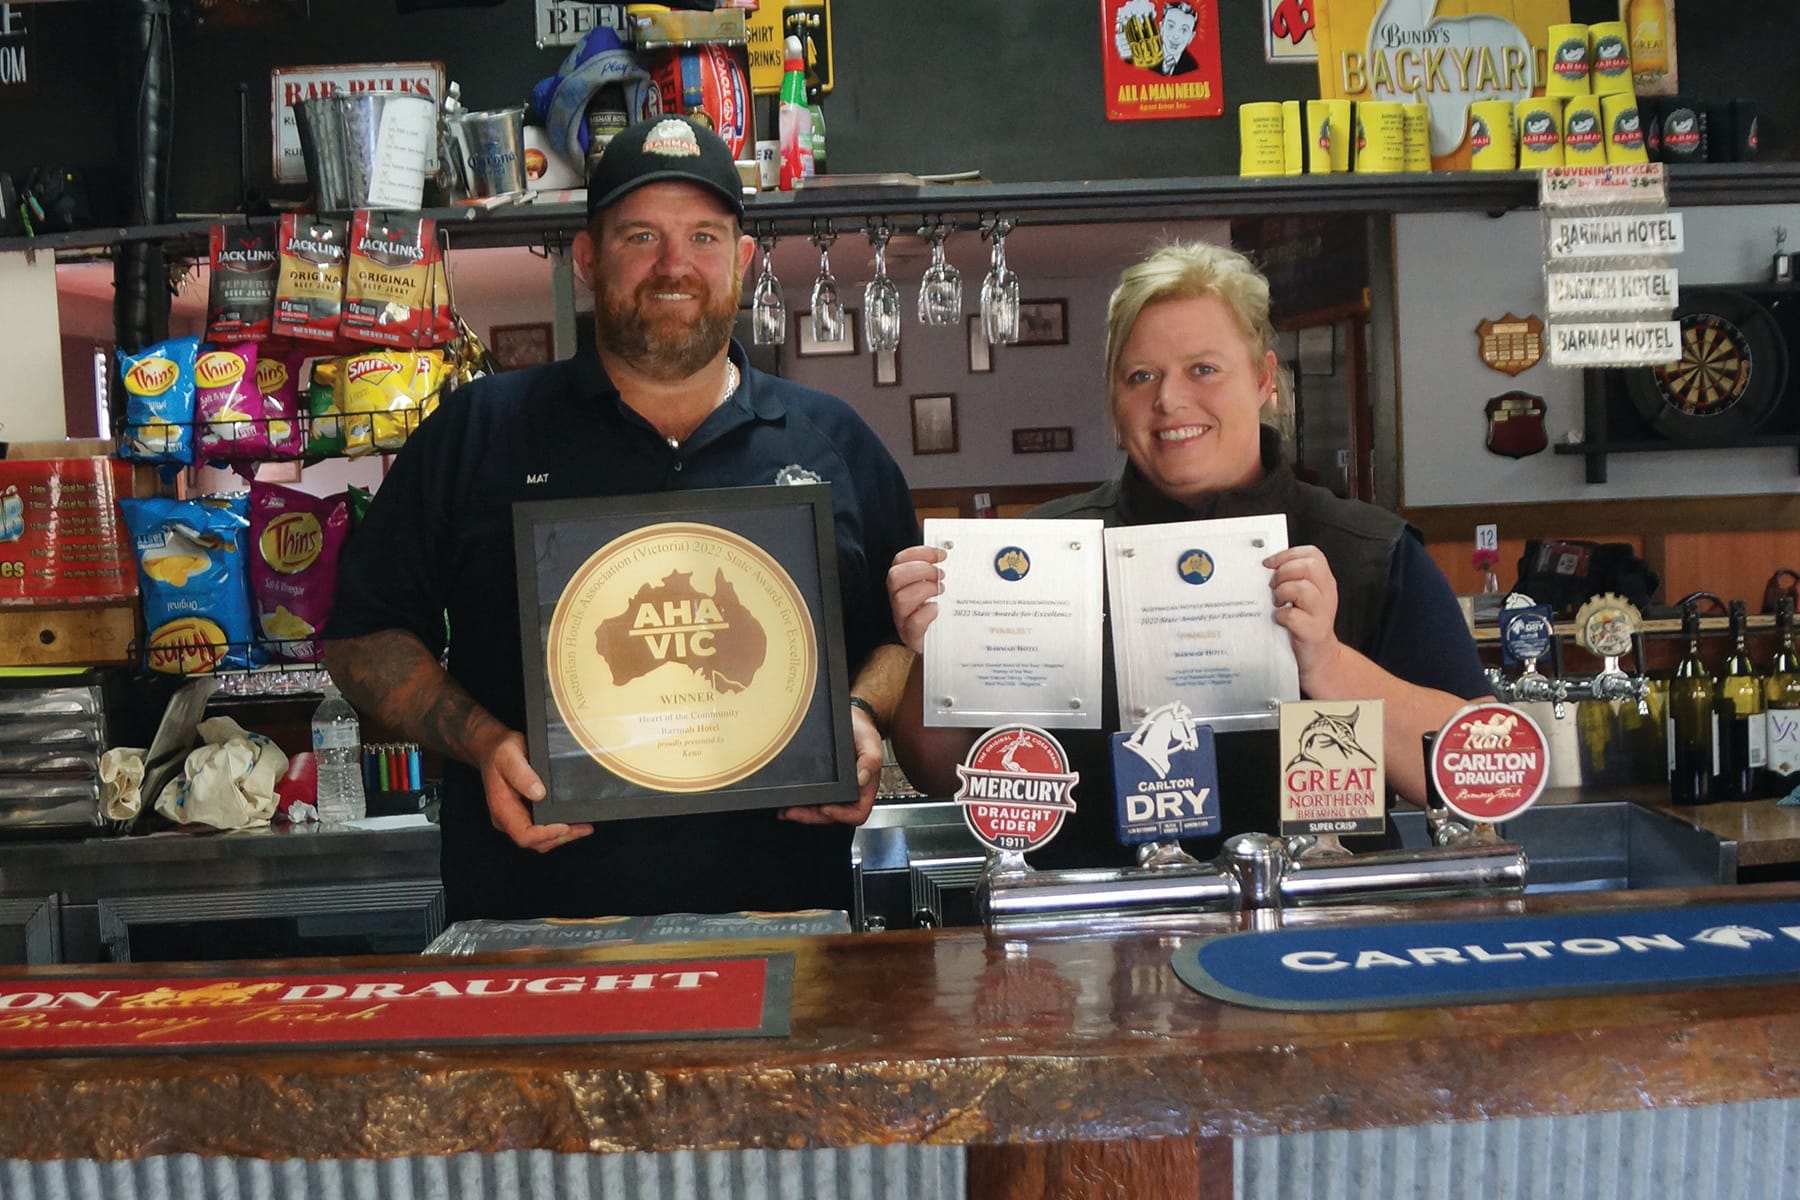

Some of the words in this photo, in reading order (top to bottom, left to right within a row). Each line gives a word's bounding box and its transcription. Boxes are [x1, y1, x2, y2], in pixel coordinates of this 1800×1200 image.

[546, 5, 627, 34] BEE
[1381, 22, 1450, 49] BUNDY'S
[1341, 45, 1547, 95] BACKYARD
[1554, 61, 1589, 74] BARMA
[1595, 57, 1631, 72] BARMA
[1118, 84, 1139, 102] ALL
[1140, 84, 1150, 102] A
[1149, 83, 1175, 101] MAN
[1175, 81, 1211, 100] NEEDS
[1546, 166, 1607, 178] SUVENIR
[1609, 163, 1659, 176] STICKES
[1560, 221, 1622, 247] BARMAH
[1627, 219, 1677, 243] HOTEL
[286, 238, 317, 253] JACK
[356, 237, 388, 254] JACK
[217, 250, 246, 263] JACK
[359, 271, 416, 288] ORIGINAL
[1558, 326, 1620, 351] BARMAH
[1624, 326, 1673, 350] HOTEL
[127, 361, 174, 389] Thins
[197, 354, 240, 383] Thins
[257, 364, 284, 385] hins
[526, 473, 549, 484] MAT
[267, 517, 317, 559] Thins
[1480, 529, 1494, 547] 12
[633, 541, 690, 562] (Victoria)
[693, 541, 722, 558] 2022
[724, 550, 752, 572] State
[580, 557, 632, 609] Association
[751, 571, 784, 608] Awards
[167, 598, 198, 612] Original
[633, 598, 724, 629] AHA
[953, 609, 971, 617] 2022
[779, 609, 792, 626] for
[566, 607, 585, 647] Hotels
[1525, 622, 1545, 632] DRY
[644, 630, 717, 659] VIC
[786, 628, 801, 693] Excellence
[565, 651, 590, 710] Australian
[660, 692, 714, 704] WINNER
[639, 714, 662, 722] Heart
[690, 709, 739, 720] Community
[661, 725, 695, 735] Barmah
[697, 723, 719, 733] Hotel
[657, 738, 682, 750] proudly
[684, 736, 715, 747] presented
[1443, 753, 1537, 772] CARLTON
[1138, 777, 1195, 792] CARLTON
[1287, 767, 1378, 793] GREAT
[1454, 771, 1526, 785] DRAUGHT
[969, 776, 1067, 803] MERCURY
[1126, 788, 1210, 822] DRY
[1289, 792, 1376, 809] NORTHERN
[977, 807, 1051, 821] DRAUGHT
[1297, 808, 1346, 819] BREWING
[990, 819, 1036, 832] CIDER
[1309, 823, 1338, 832] SUPER
[1338, 821, 1358, 831] CRISP
[1000, 836, 1025, 848] 1911
[1281, 932, 1687, 973] CARLTON
[281, 971, 719, 1001] DRAUGHT
[0, 1012, 210, 1040] Brewery
[236, 1003, 389, 1025] Fresh
